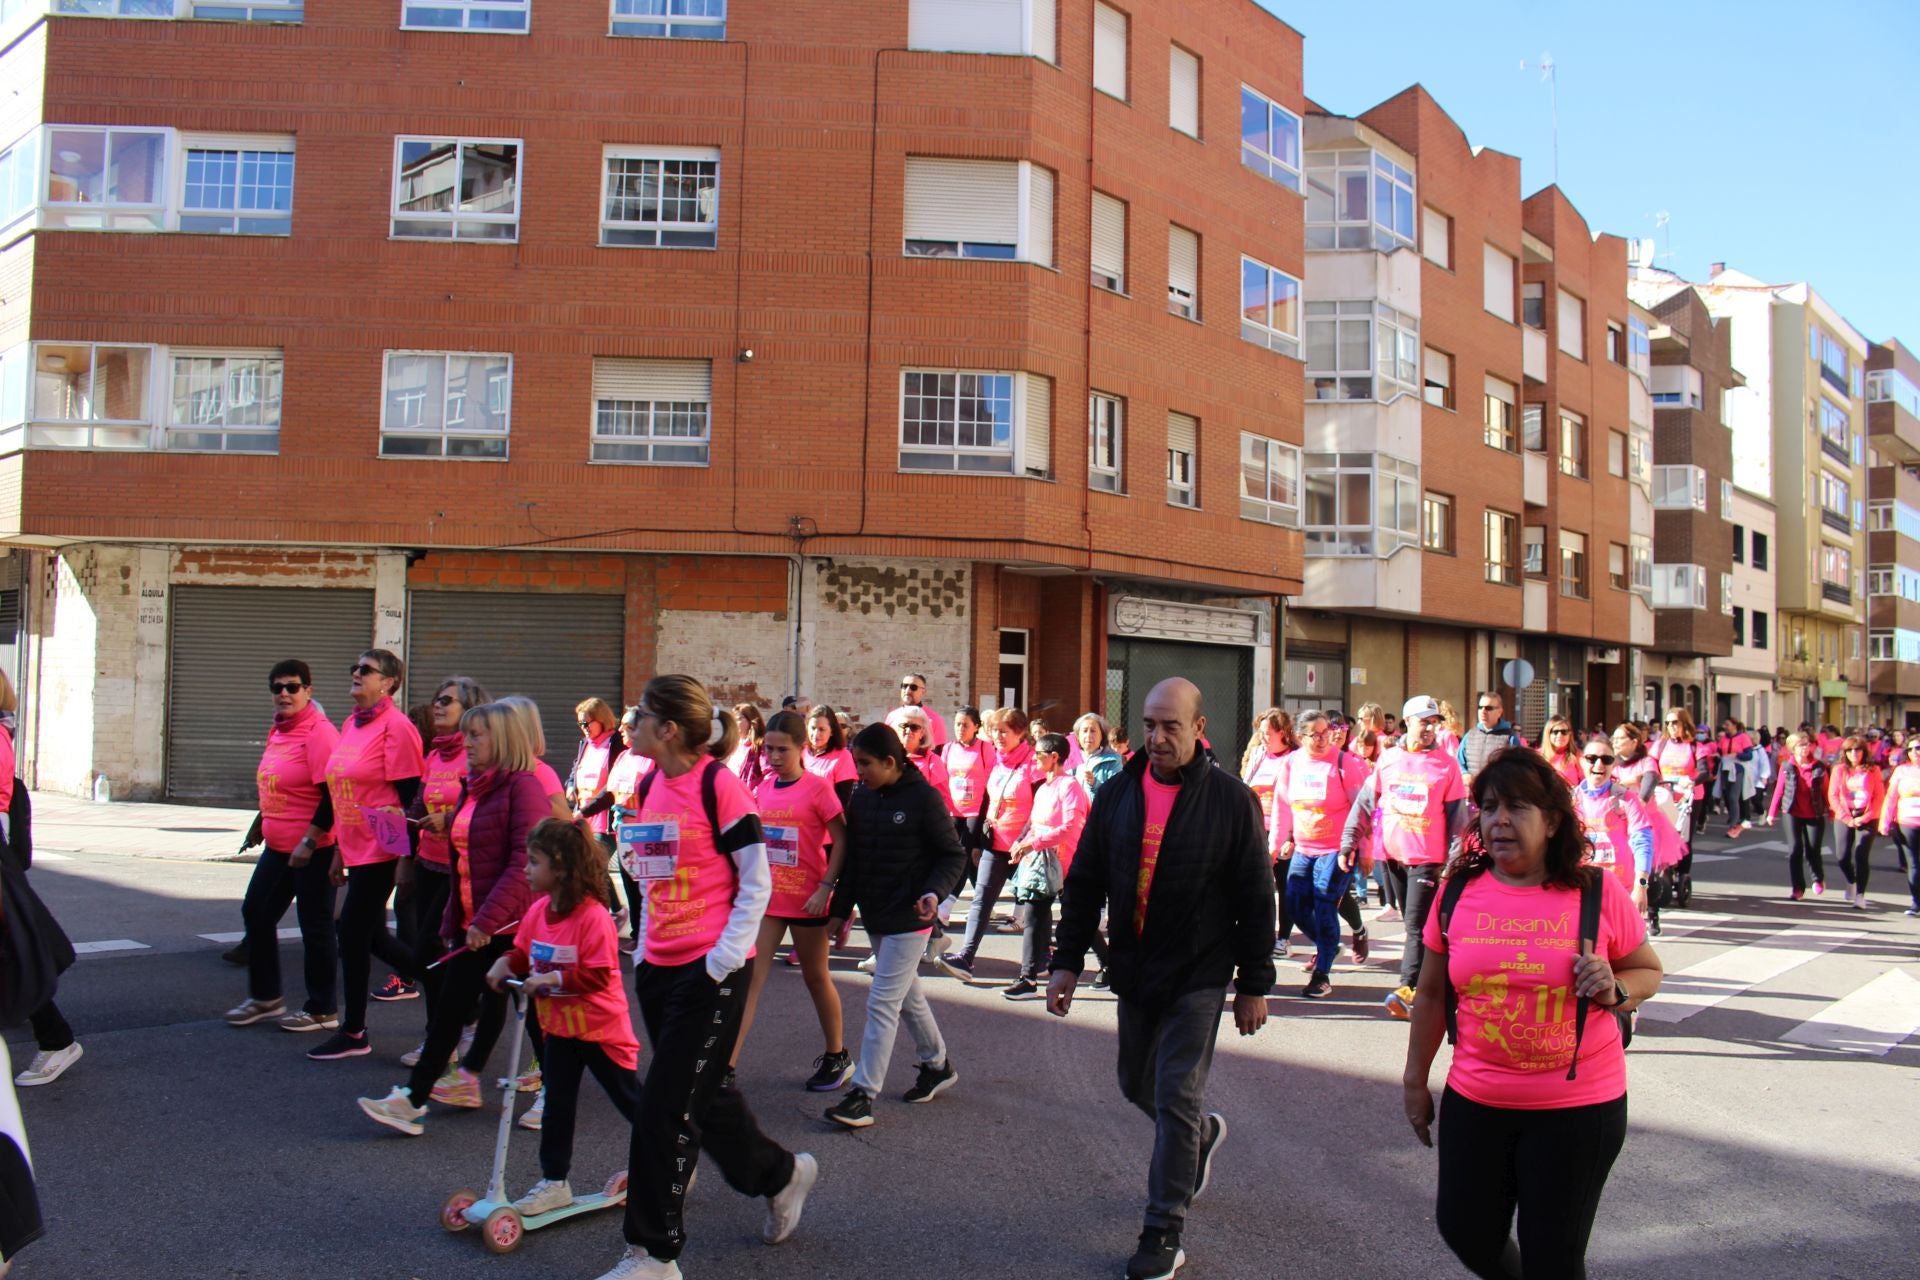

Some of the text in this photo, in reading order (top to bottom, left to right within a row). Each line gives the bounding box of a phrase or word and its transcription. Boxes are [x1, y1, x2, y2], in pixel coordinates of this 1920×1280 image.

[141, 589, 164, 598] ALQUILA
[1476, 911, 1571, 934] Drasanvi
[1500, 961, 1545, 971] SUZUKI
[1531, 1034, 1577, 1054] Muje
